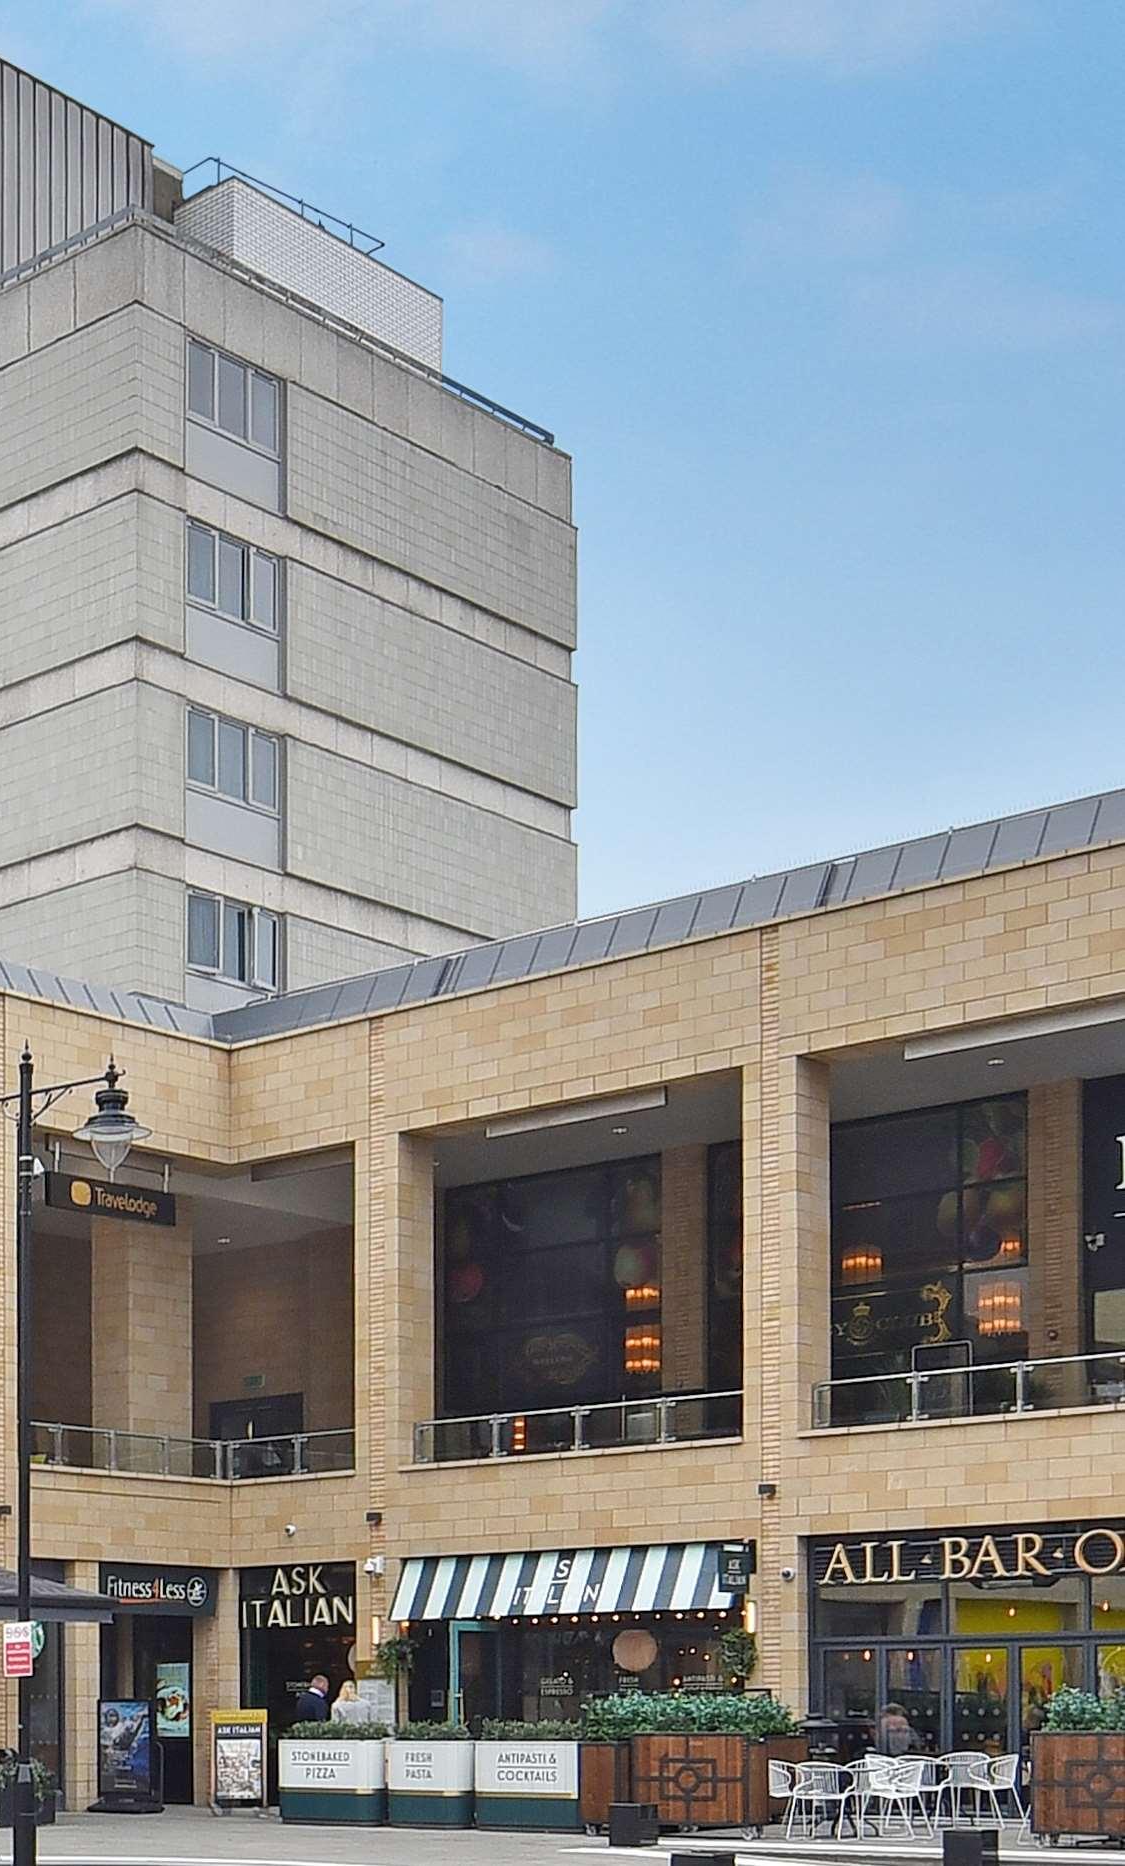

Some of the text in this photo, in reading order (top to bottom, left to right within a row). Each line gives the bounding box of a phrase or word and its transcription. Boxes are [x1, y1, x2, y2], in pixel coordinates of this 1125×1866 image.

[95, 1187, 158, 1219] Travelodge
[818, 1528, 1125, 1586] ALL BAR O
[271, 1565, 328, 1596] ASK
[107, 1576, 186, 1600] Fitness4Less
[242, 1595, 353, 1629] ITALIAN
[291, 1751, 350, 1763] STONEBAKED
[405, 1752, 433, 1763] FRESH
[497, 1753, 557, 1764] ANTIPASTI &
[305, 1767, 336, 1779] PIZZA
[405, 1768, 433, 1779] PASTA
[497, 1770, 558, 1782] COCKTAILS
